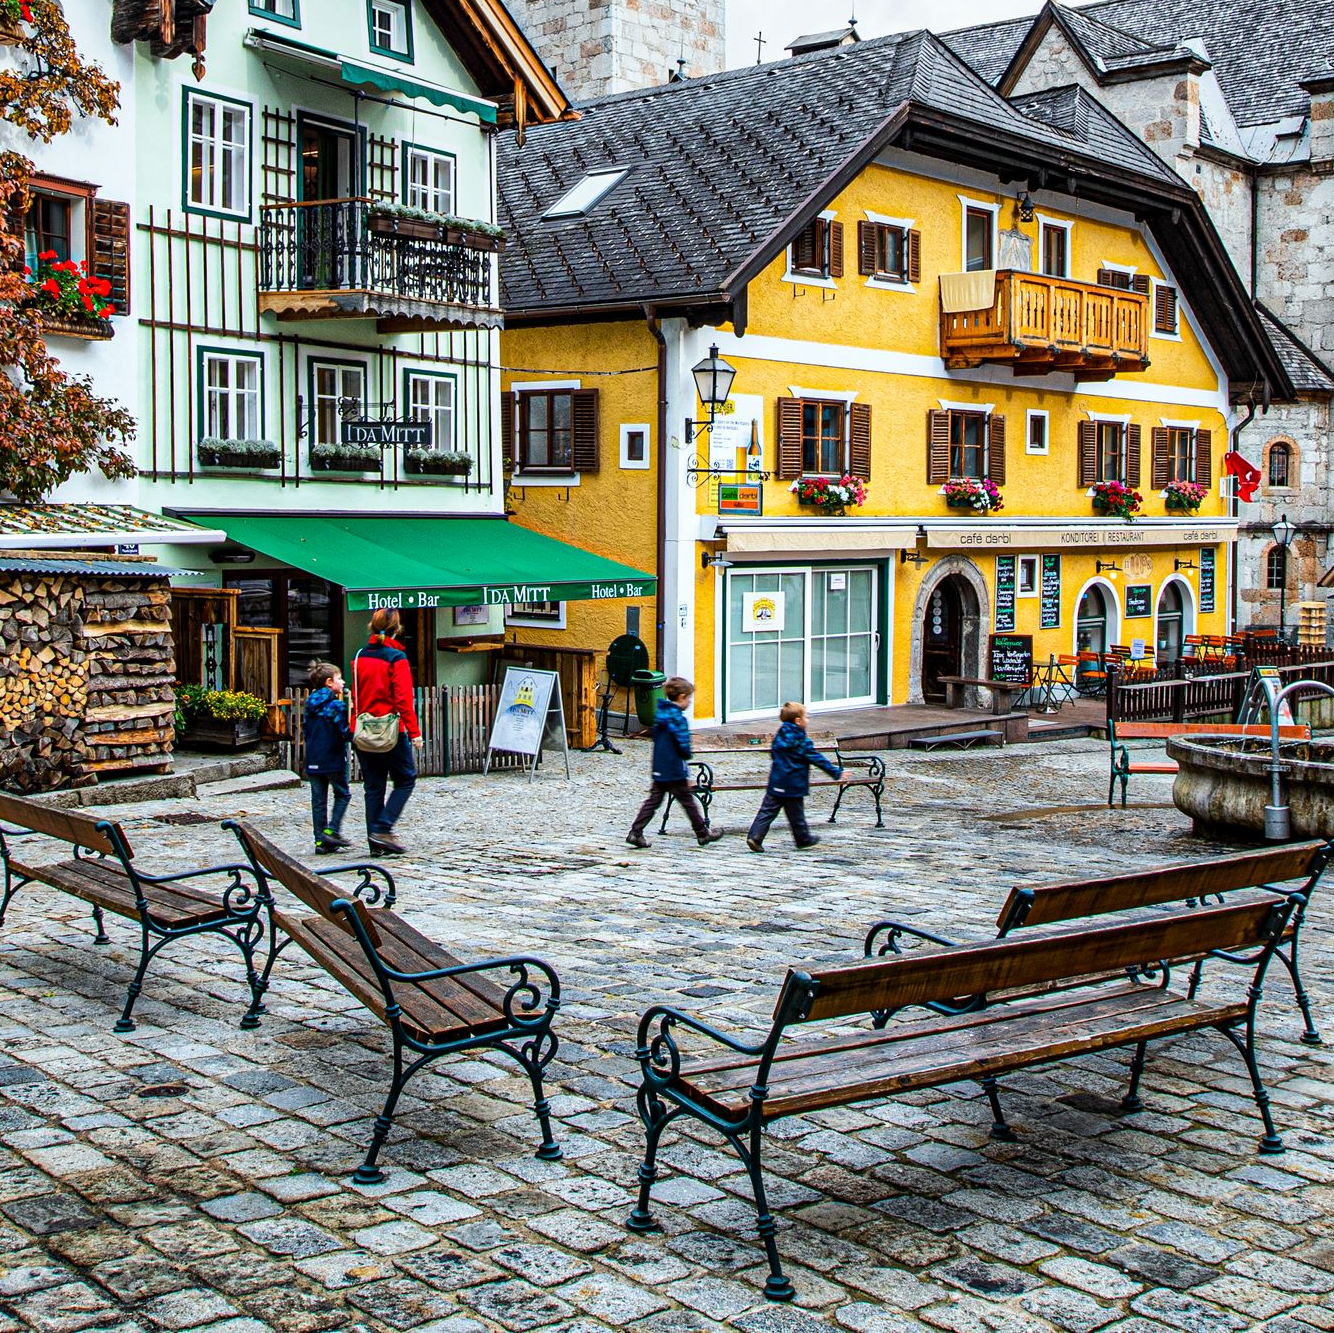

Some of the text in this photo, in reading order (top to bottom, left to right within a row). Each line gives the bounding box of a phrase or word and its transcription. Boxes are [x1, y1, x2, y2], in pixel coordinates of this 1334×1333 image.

[381, 424, 426, 443] MITT
[960, 533, 983, 544] café
[985, 533, 1012, 544] derbl
[1061, 532, 1099, 543] KONDITOREI
[1108, 531, 1145, 542] RESTAURANT
[1183, 530, 1199, 541] café
[368, 592, 403, 609] Hotel
[417, 592, 440, 608] Bar
[513, 585, 551, 603] MITT
[591, 583, 617, 599] Hotel
[626, 583, 643, 597] Bar
